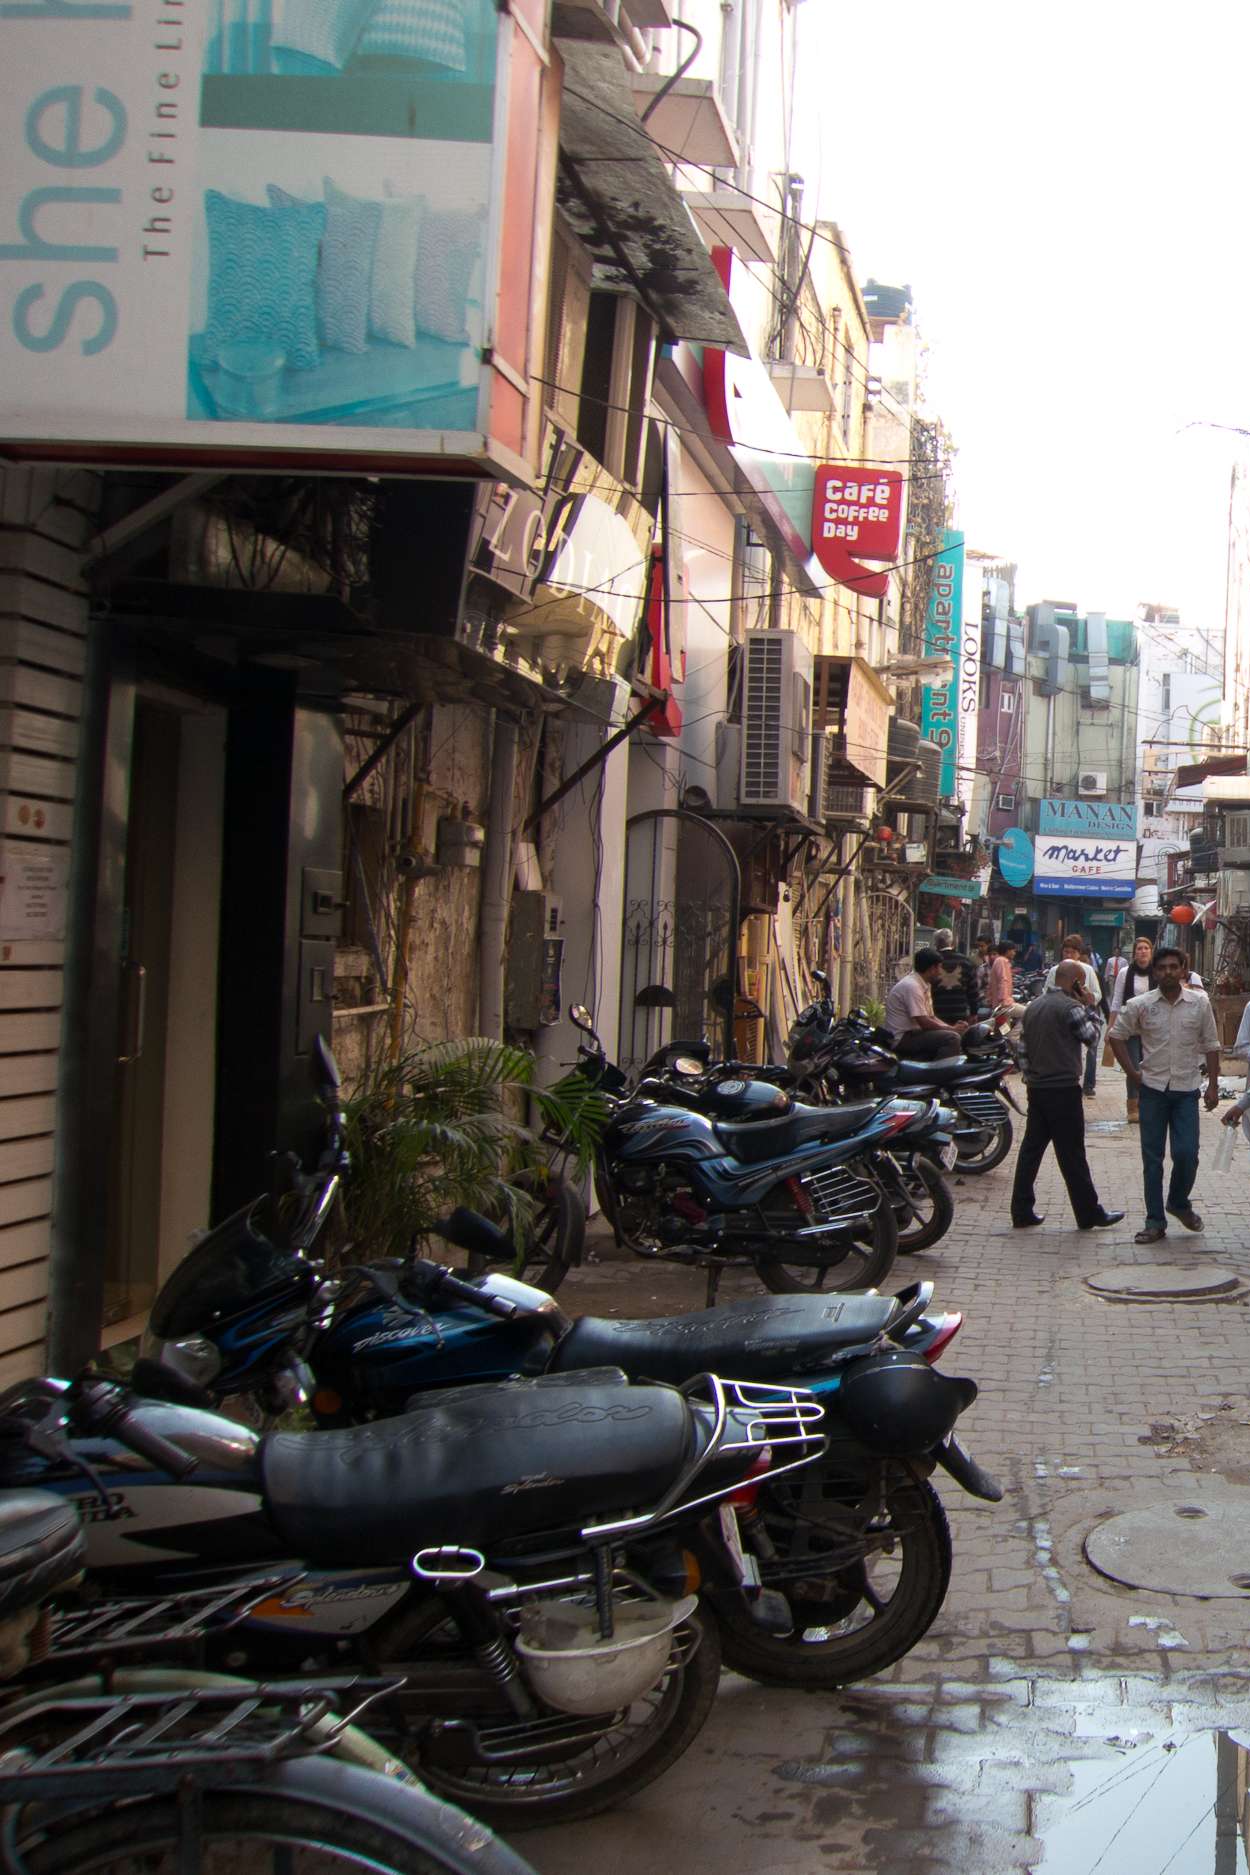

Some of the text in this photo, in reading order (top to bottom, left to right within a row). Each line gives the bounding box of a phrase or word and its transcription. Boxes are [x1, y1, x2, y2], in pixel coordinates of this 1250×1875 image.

[148, 71, 182, 166] Fine
[2, 84, 130, 356] she
[143, 183, 175, 262] The
[826, 478, 890, 505] Café
[823, 502, 889, 522] Coffee
[822, 521, 859, 541] Day
[930, 562, 957, 722] apartnt
[961, 621, 979, 713] LOOKS
[1046, 800, 1134, 822] MANAN
[1088, 820, 1134, 831] DESIGN
[1071, 864, 1103, 875] CAFE
[352, 1321, 451, 1355] Discover
